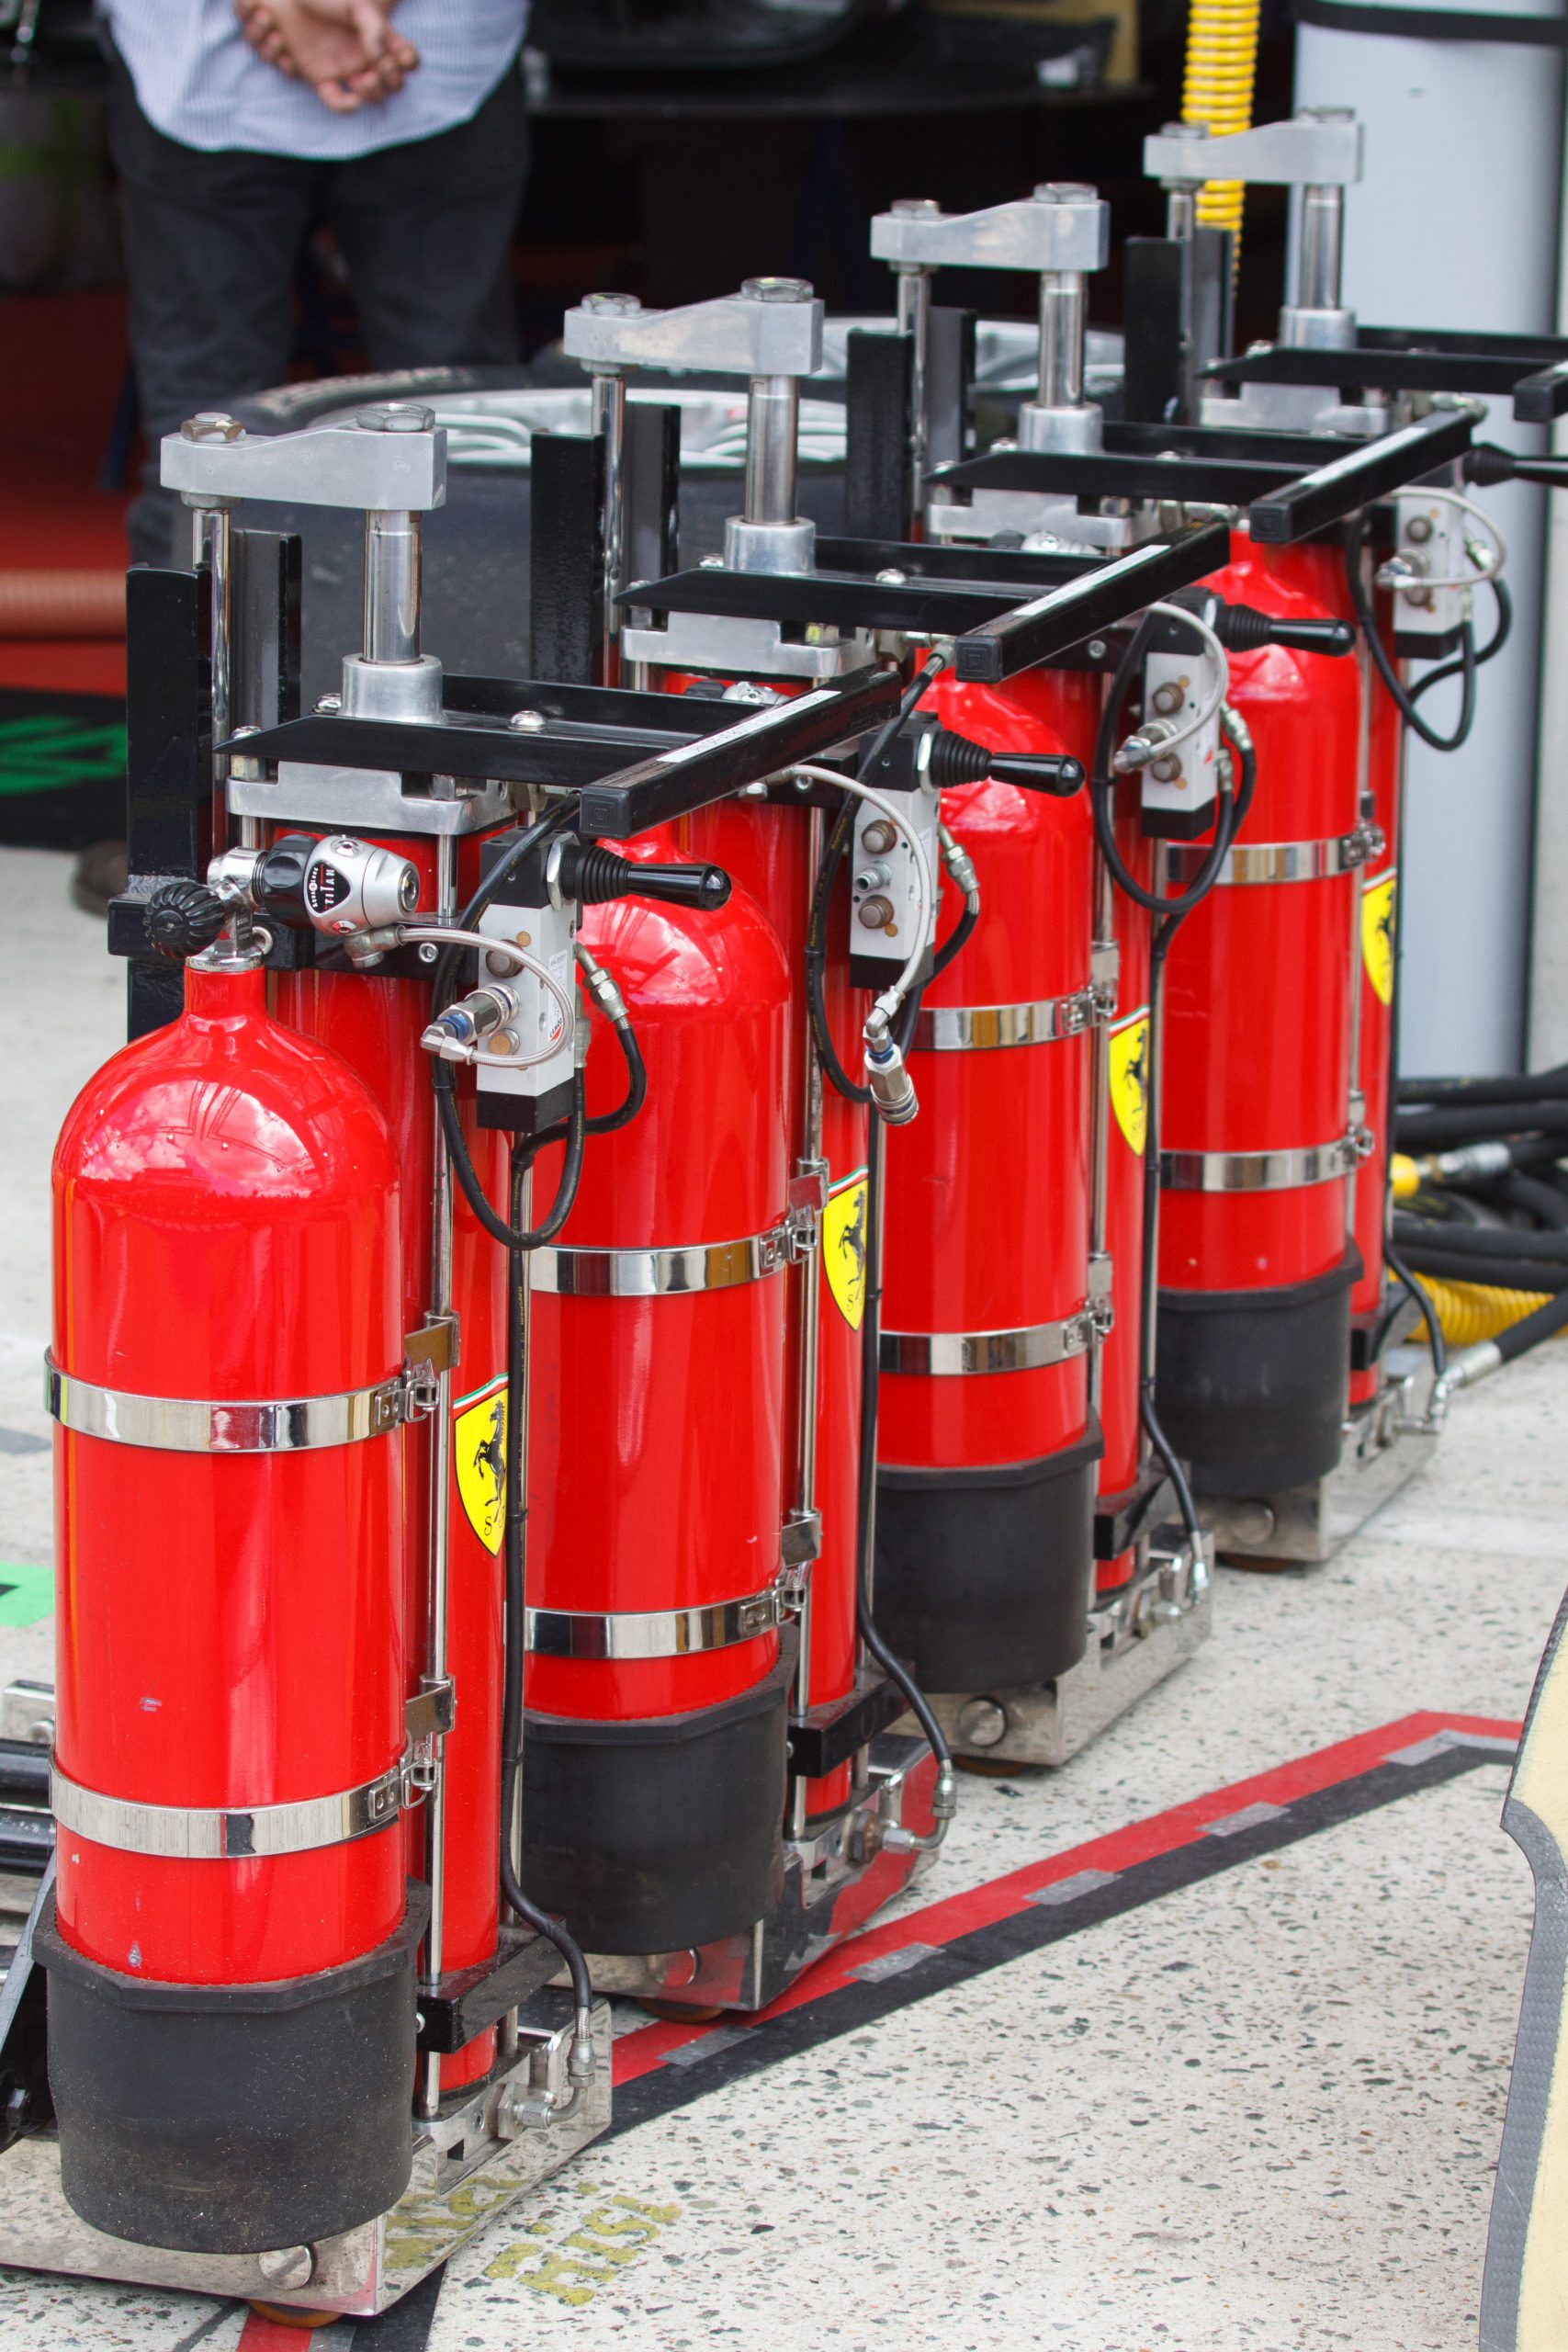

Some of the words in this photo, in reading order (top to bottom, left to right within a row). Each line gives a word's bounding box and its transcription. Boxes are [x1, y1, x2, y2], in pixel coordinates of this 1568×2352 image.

[321, 869, 334, 904] TITAN
[847, 1294, 853, 1312] S
[484, 1516, 492, 1536] S
